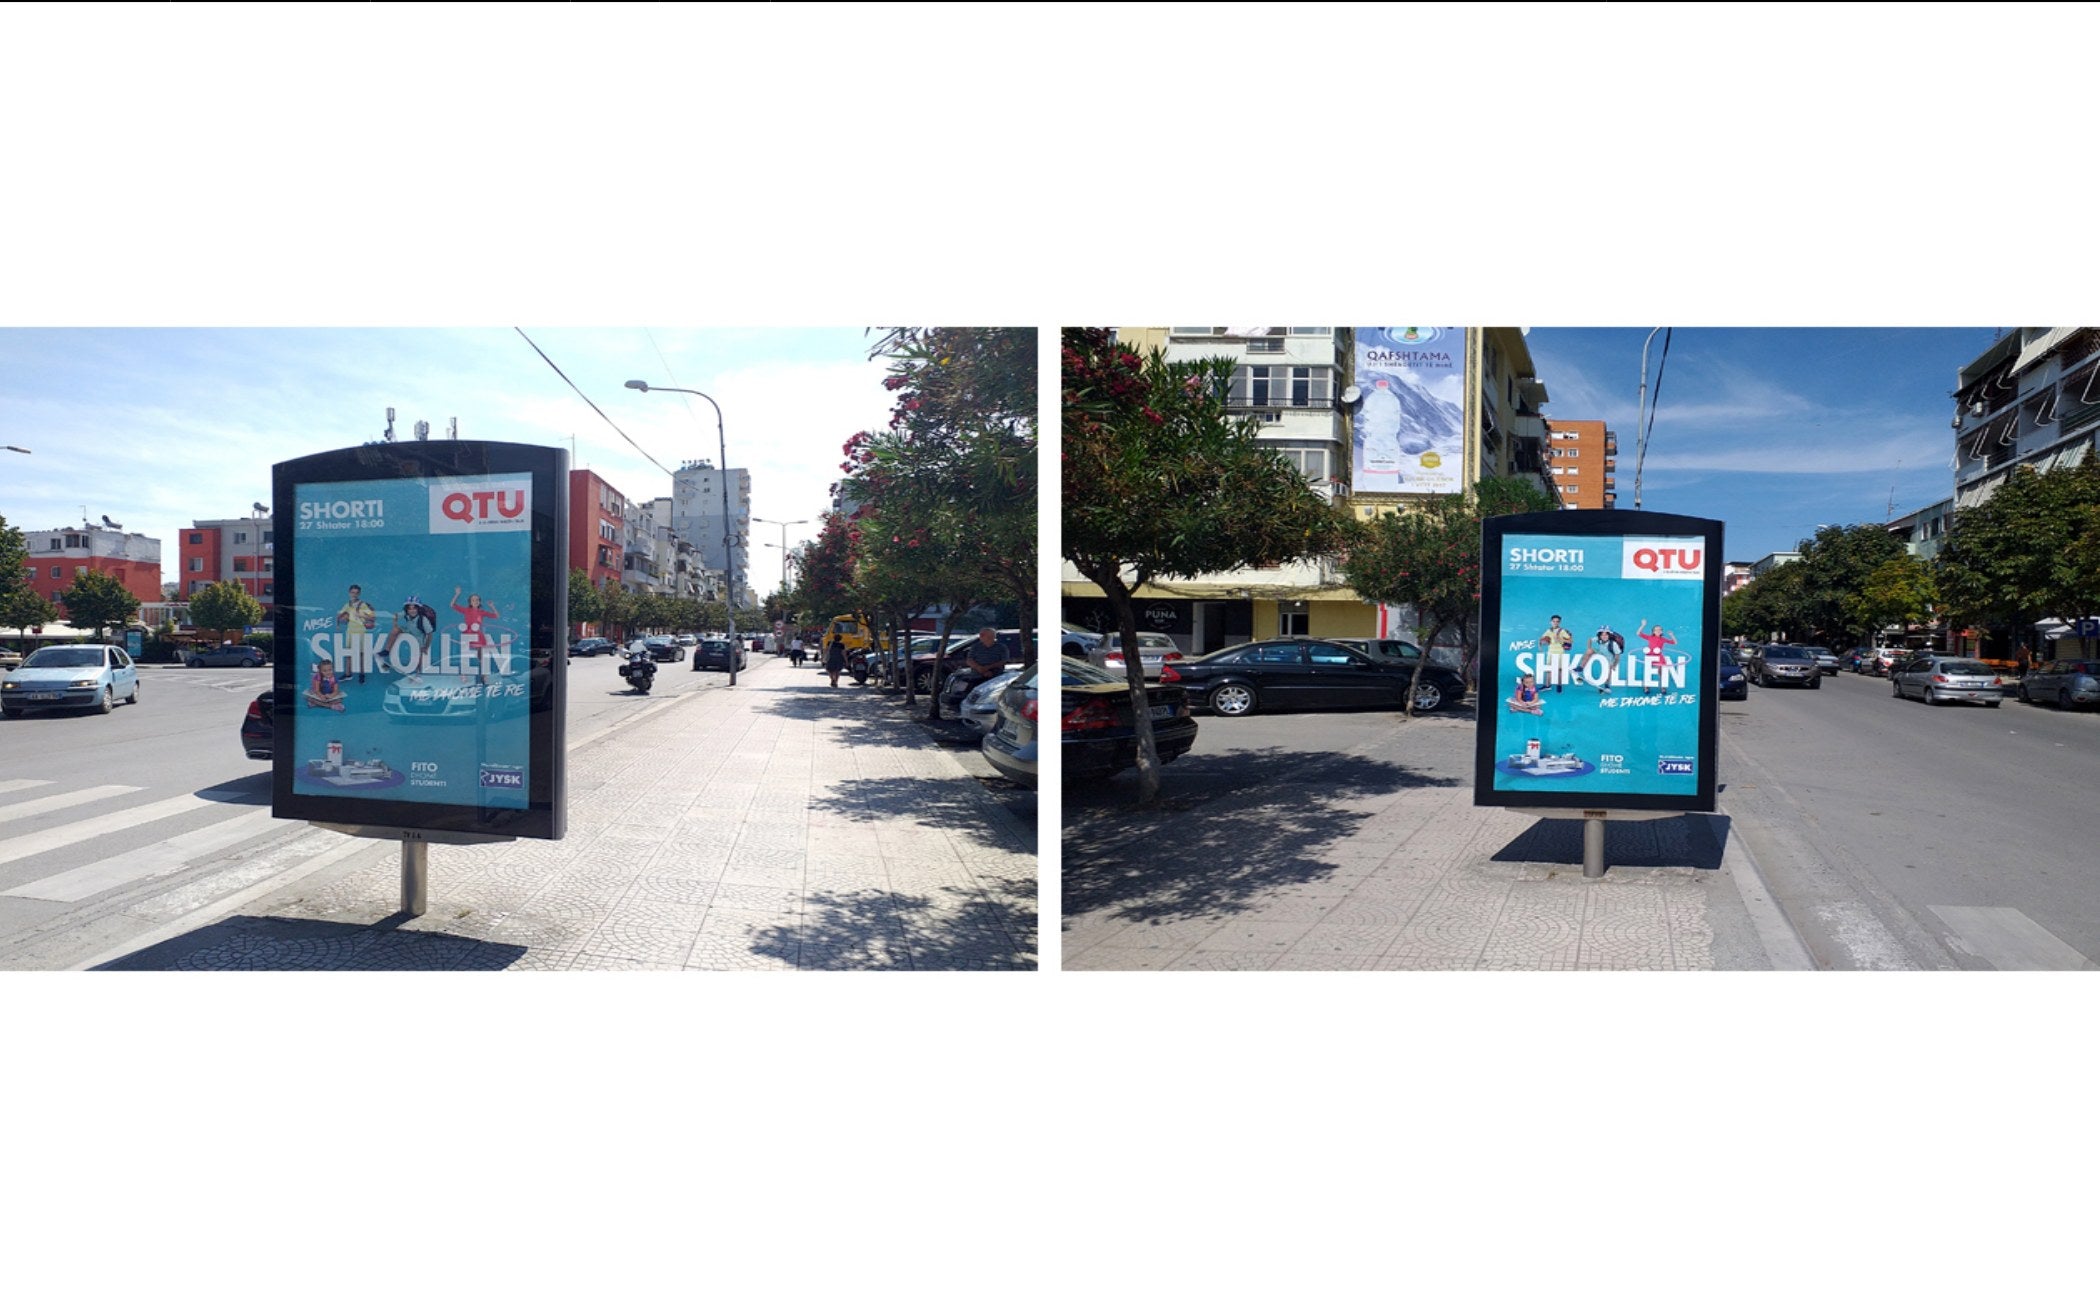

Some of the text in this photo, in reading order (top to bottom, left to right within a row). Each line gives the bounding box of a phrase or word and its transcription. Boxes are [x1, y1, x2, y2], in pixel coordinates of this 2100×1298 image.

[1367, 351, 1451, 361] QAFSHTAMA
[300, 500, 383, 519] SHORTI
[443, 490, 524, 523] QTU
[300, 521, 313, 529] 27
[1510, 548, 1584, 563] SHORTI
[1633, 548, 1700, 572] QTU
[2082, 621, 2095, 635] P
[411, 762, 438, 772] FITO
[1665, 763, 1691, 771] JYSK
[489, 774, 521, 784] JYSK
